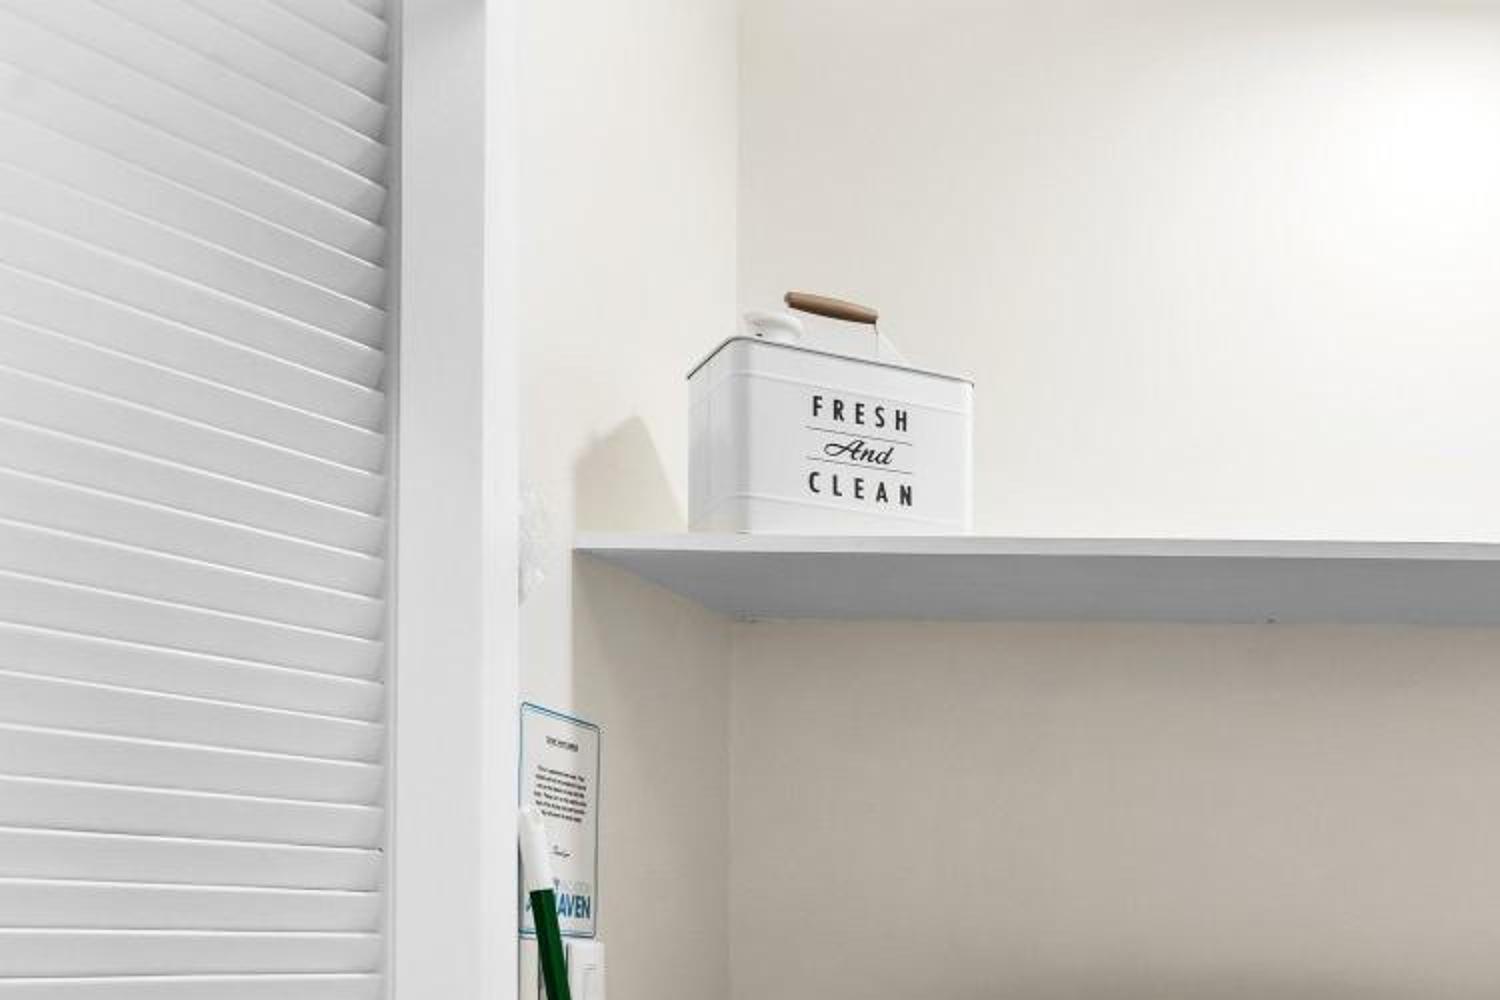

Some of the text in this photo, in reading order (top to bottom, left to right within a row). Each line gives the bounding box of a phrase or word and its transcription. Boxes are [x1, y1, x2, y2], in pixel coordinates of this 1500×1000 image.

[812, 395, 908, 432] FRESH
[824, 439, 895, 465] And
[808, 471, 913, 507] CLEAN
[556, 893, 591, 920] AVEN
